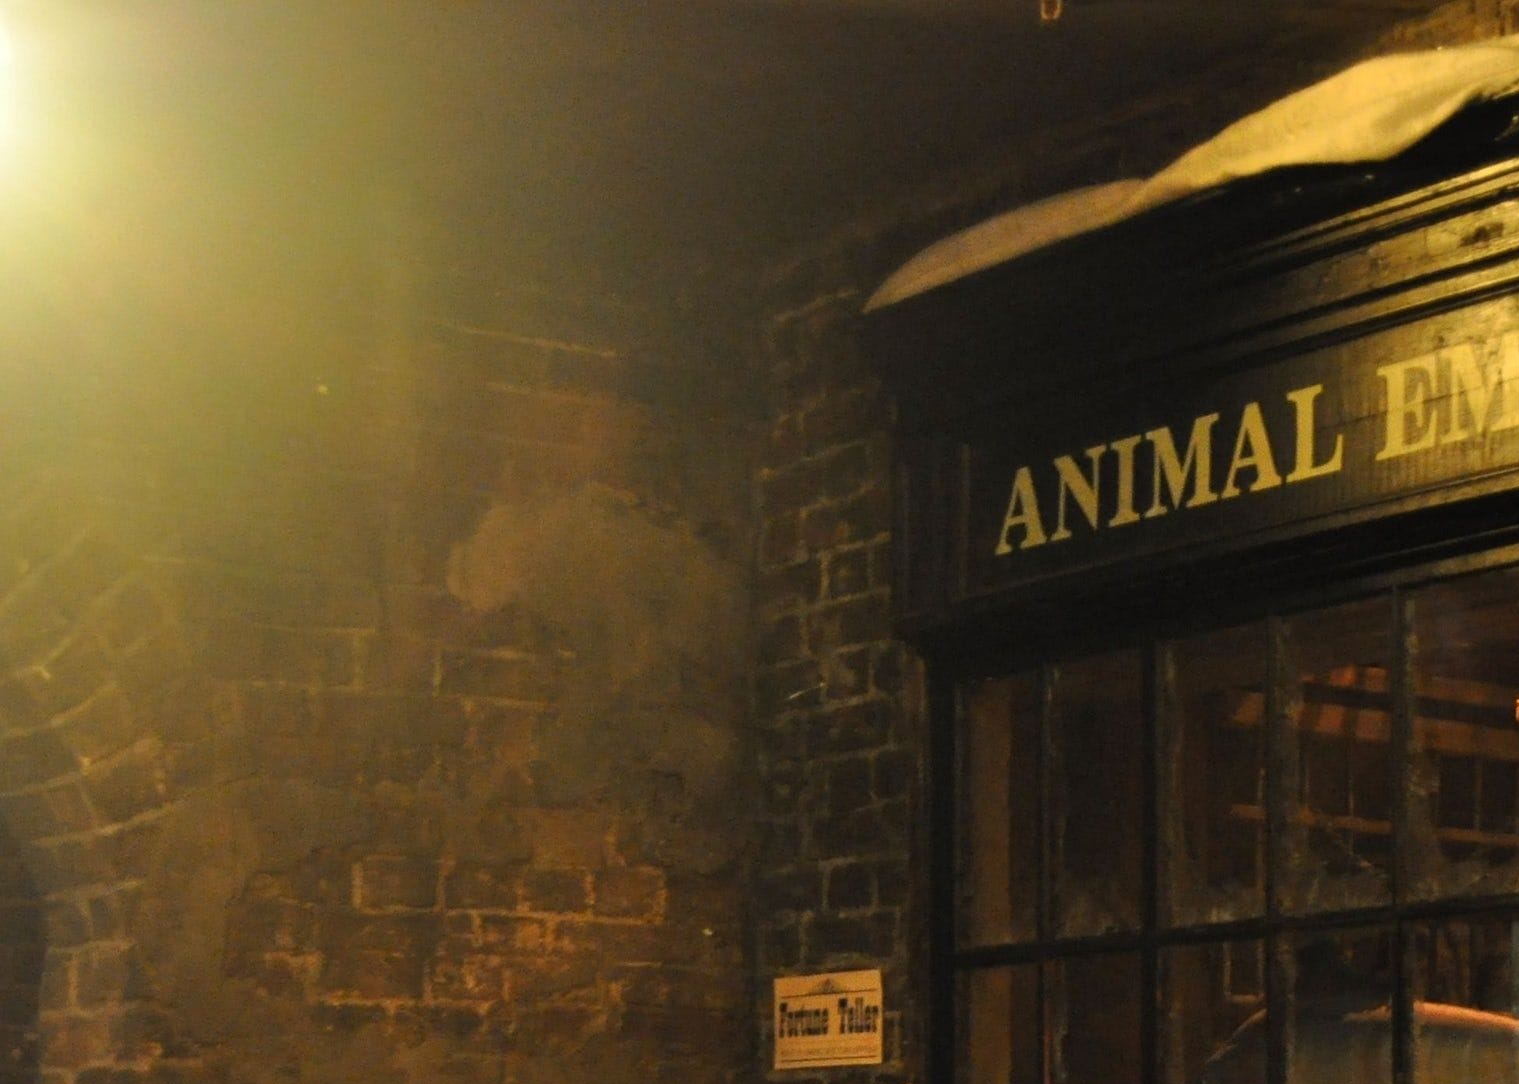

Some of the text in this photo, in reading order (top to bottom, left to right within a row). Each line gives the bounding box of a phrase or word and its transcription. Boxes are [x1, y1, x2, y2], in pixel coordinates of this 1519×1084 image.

[995, 383, 1346, 556] ANIMAL
[778, 997, 879, 1038] Fortune Teller
